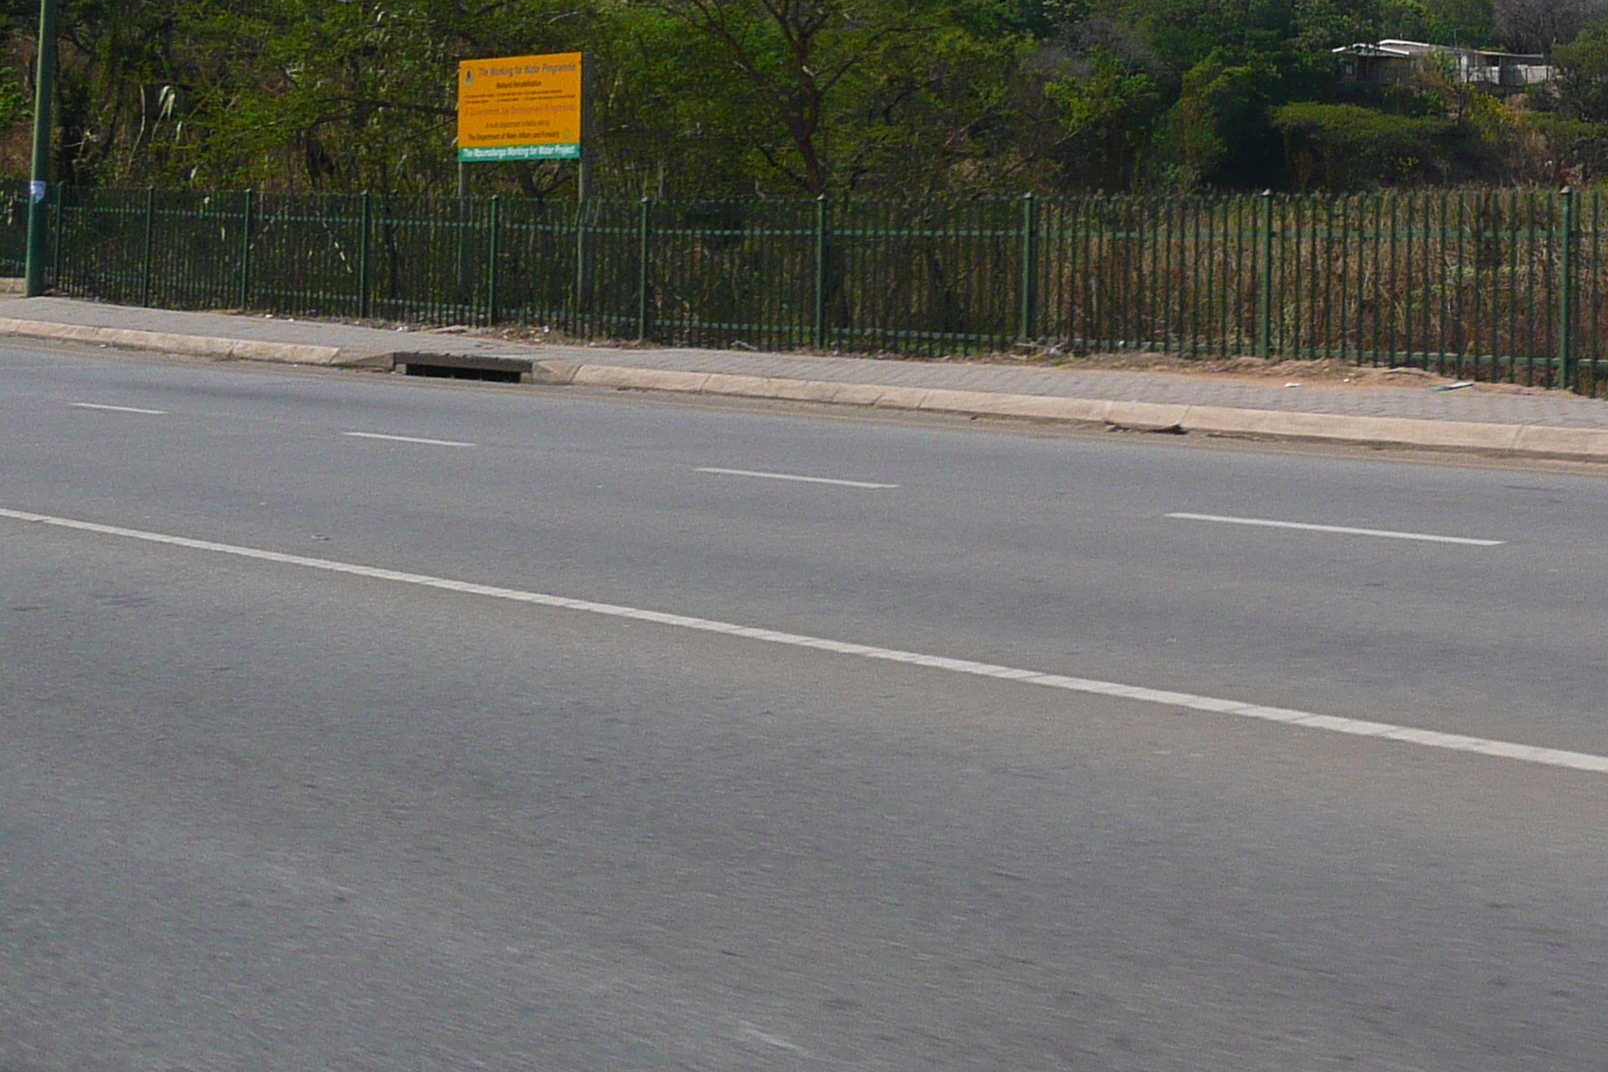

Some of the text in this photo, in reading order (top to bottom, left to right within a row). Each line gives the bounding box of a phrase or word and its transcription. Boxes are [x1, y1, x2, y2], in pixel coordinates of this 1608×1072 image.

[478, 63, 576, 78] The Working for Water Programme
[476, 133, 500, 141] Department
[463, 148, 473, 157] The
[507, 146, 529, 158] Working
[530, 145, 538, 155] for
[538, 145, 555, 154] Water
[555, 144, 575, 157] Project
